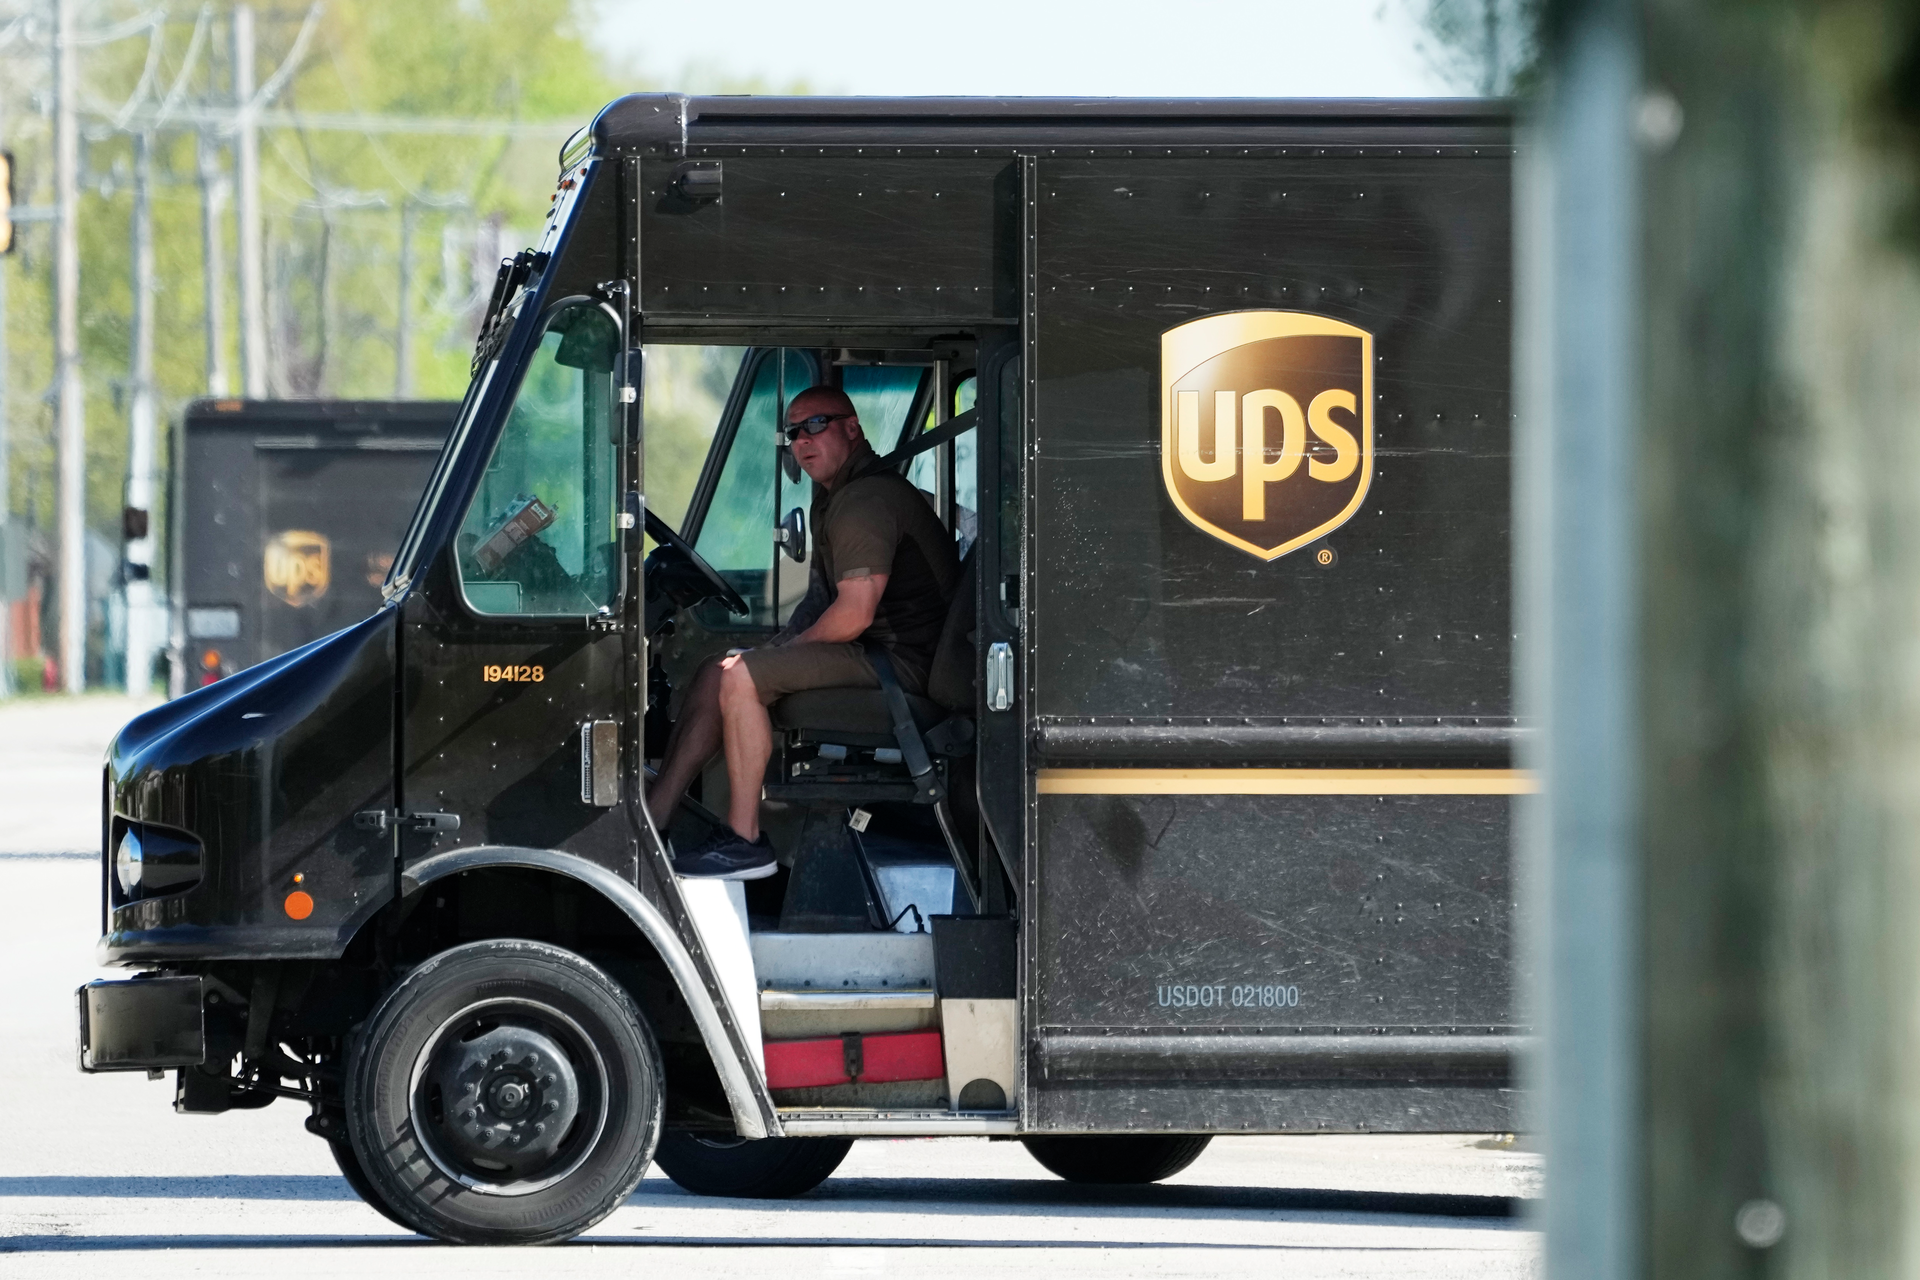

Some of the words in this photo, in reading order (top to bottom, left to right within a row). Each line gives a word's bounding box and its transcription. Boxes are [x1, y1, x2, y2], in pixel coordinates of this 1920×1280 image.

[1177, 388, 1360, 522] ups
[267, 550, 323, 597] ups
[483, 664, 545, 683] 194128
[1157, 985, 1227, 1007] USDOT
[1230, 985, 1299, 1007] 021800
